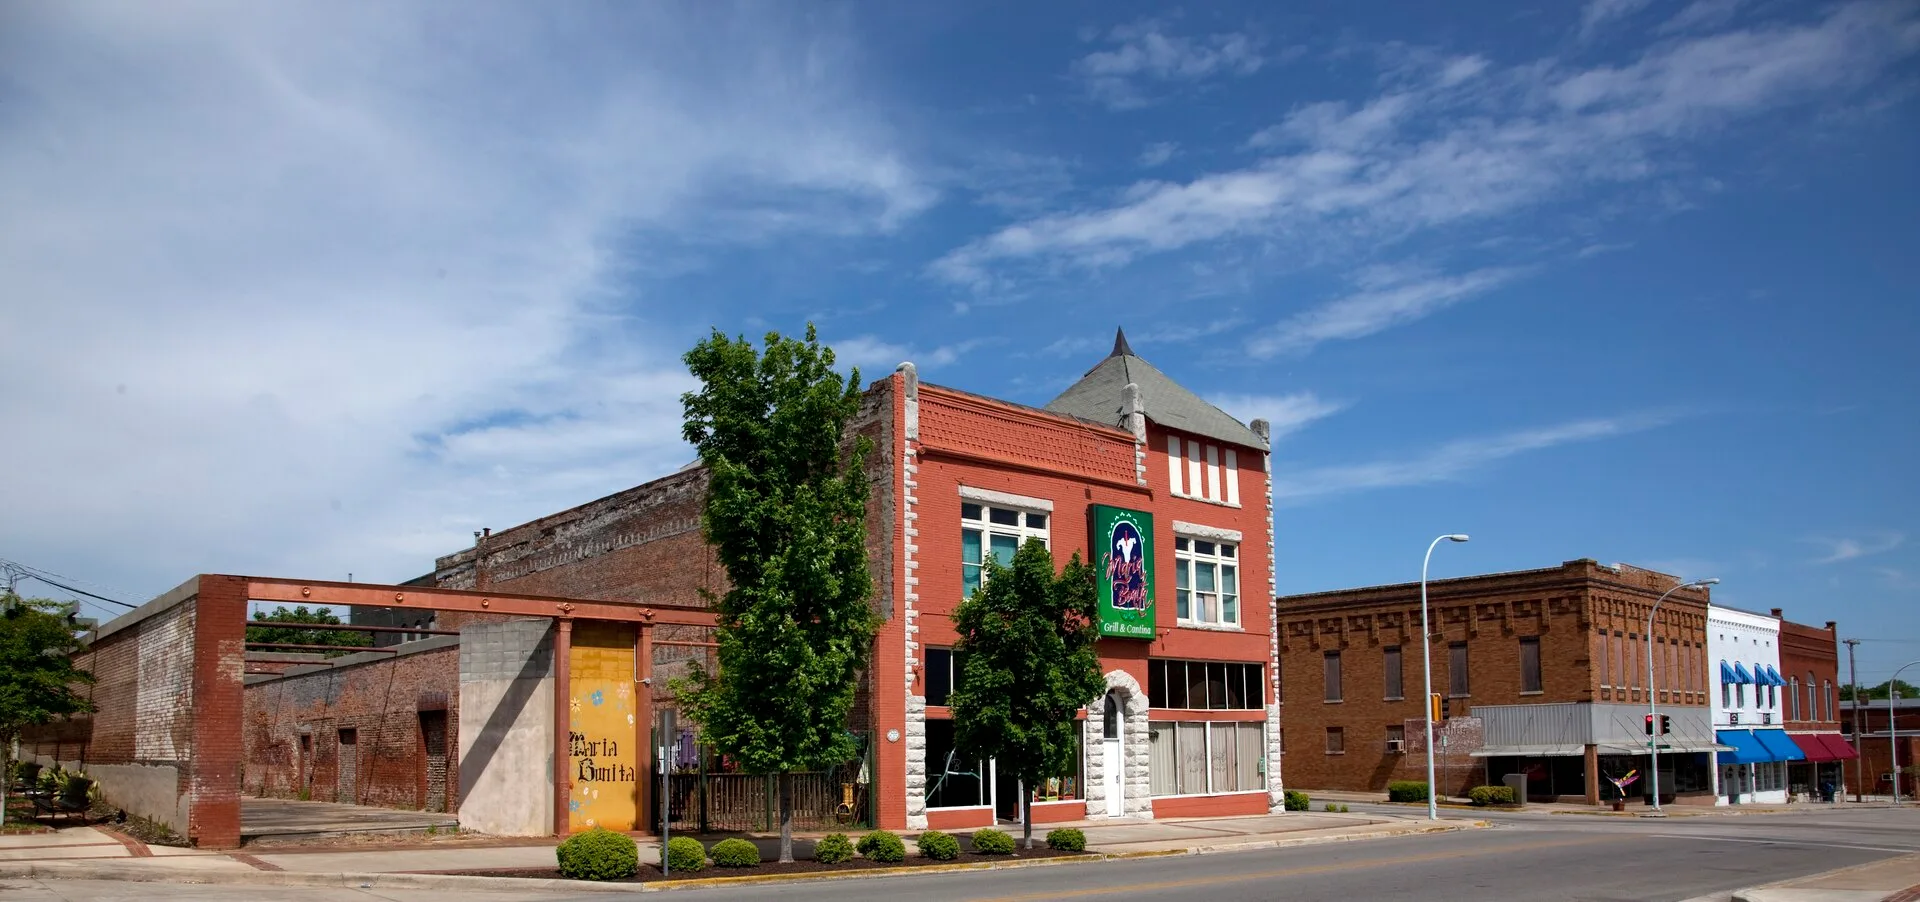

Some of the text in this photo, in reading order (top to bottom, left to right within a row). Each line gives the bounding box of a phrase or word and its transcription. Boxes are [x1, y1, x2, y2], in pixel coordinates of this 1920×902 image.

[1102, 552, 1146, 580] Maria
[1104, 622, 1152, 634] Grill & Cantina
[569, 731, 618, 757] Maria
